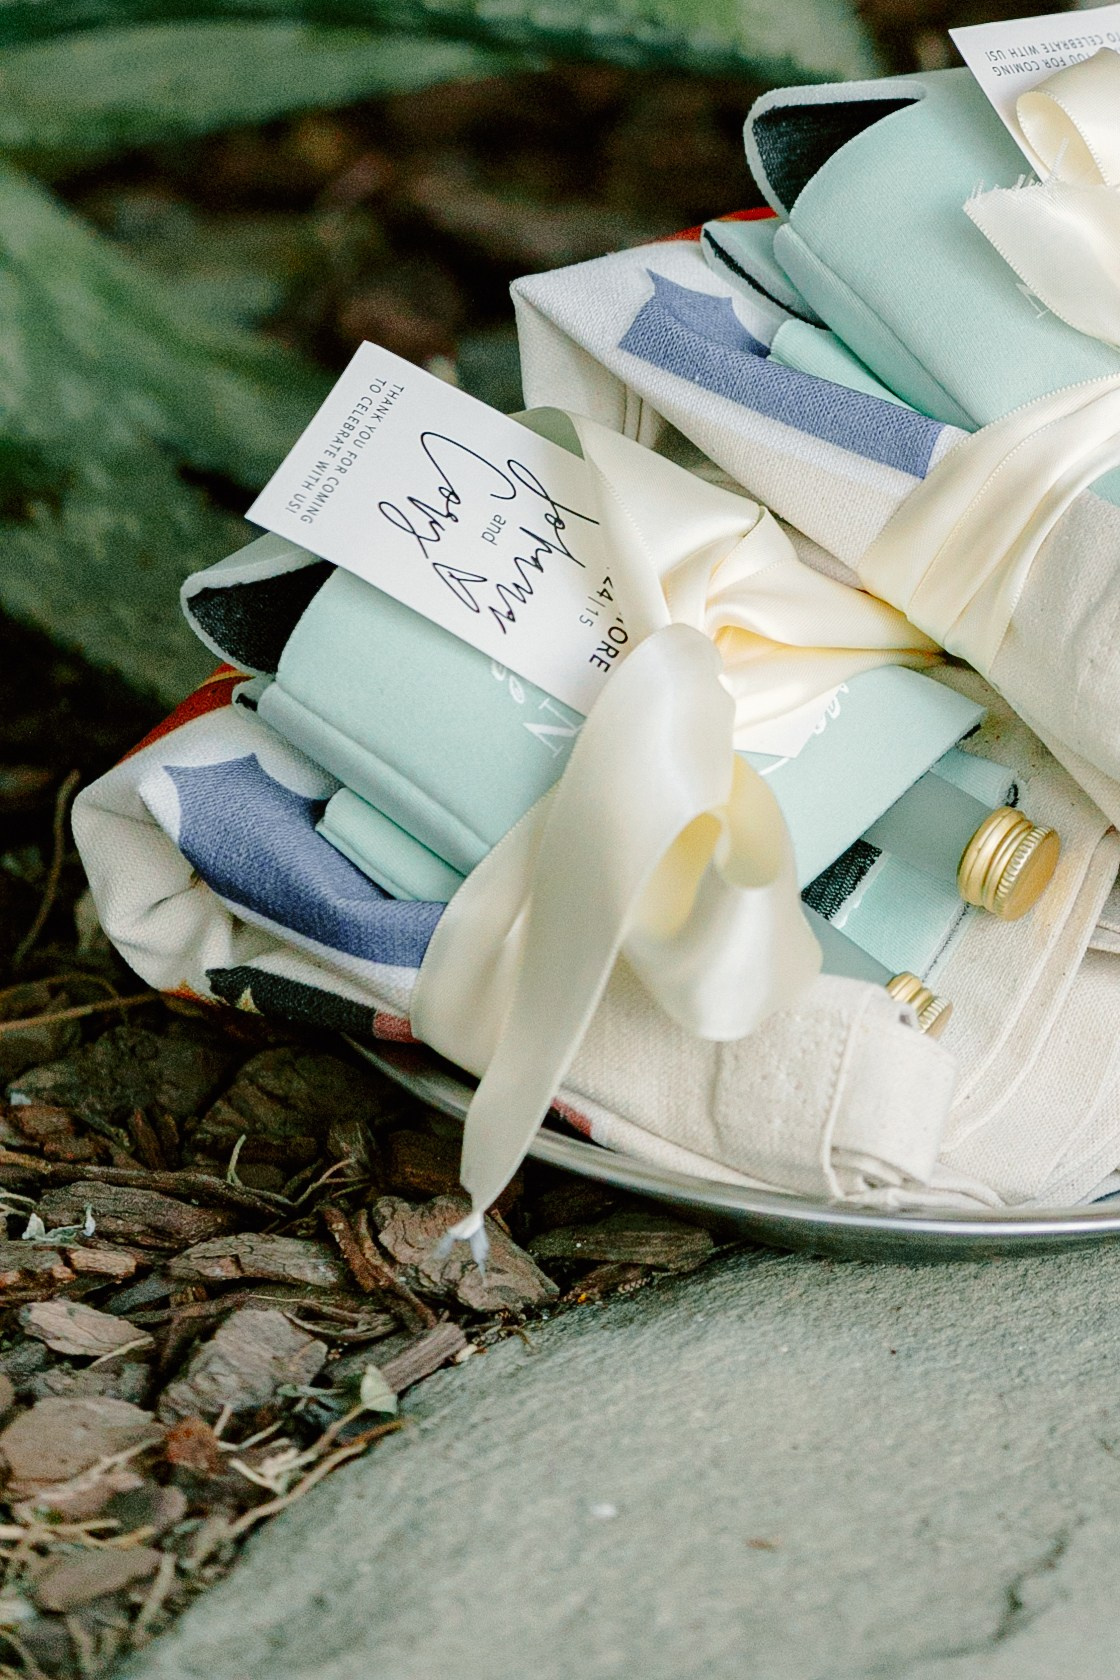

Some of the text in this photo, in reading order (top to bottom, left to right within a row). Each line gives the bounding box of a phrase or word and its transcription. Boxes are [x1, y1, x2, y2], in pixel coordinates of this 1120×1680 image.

[985, 50, 1006, 62] US!
[1009, 44, 1040, 59] WITH
[1043, 34, 1104, 54] CELEBRATE
[992, 62, 1040, 77] COMING
[1044, 57, 1067, 70] FOR
[284, 377, 387, 514] TO CELEBRATE WITH US!
[299, 384, 405, 525] THANK YOU FOR COMING
[378, 432, 517, 559] Cory
[481, 513, 507, 547] and
[589, 616, 628, 673] ORE
